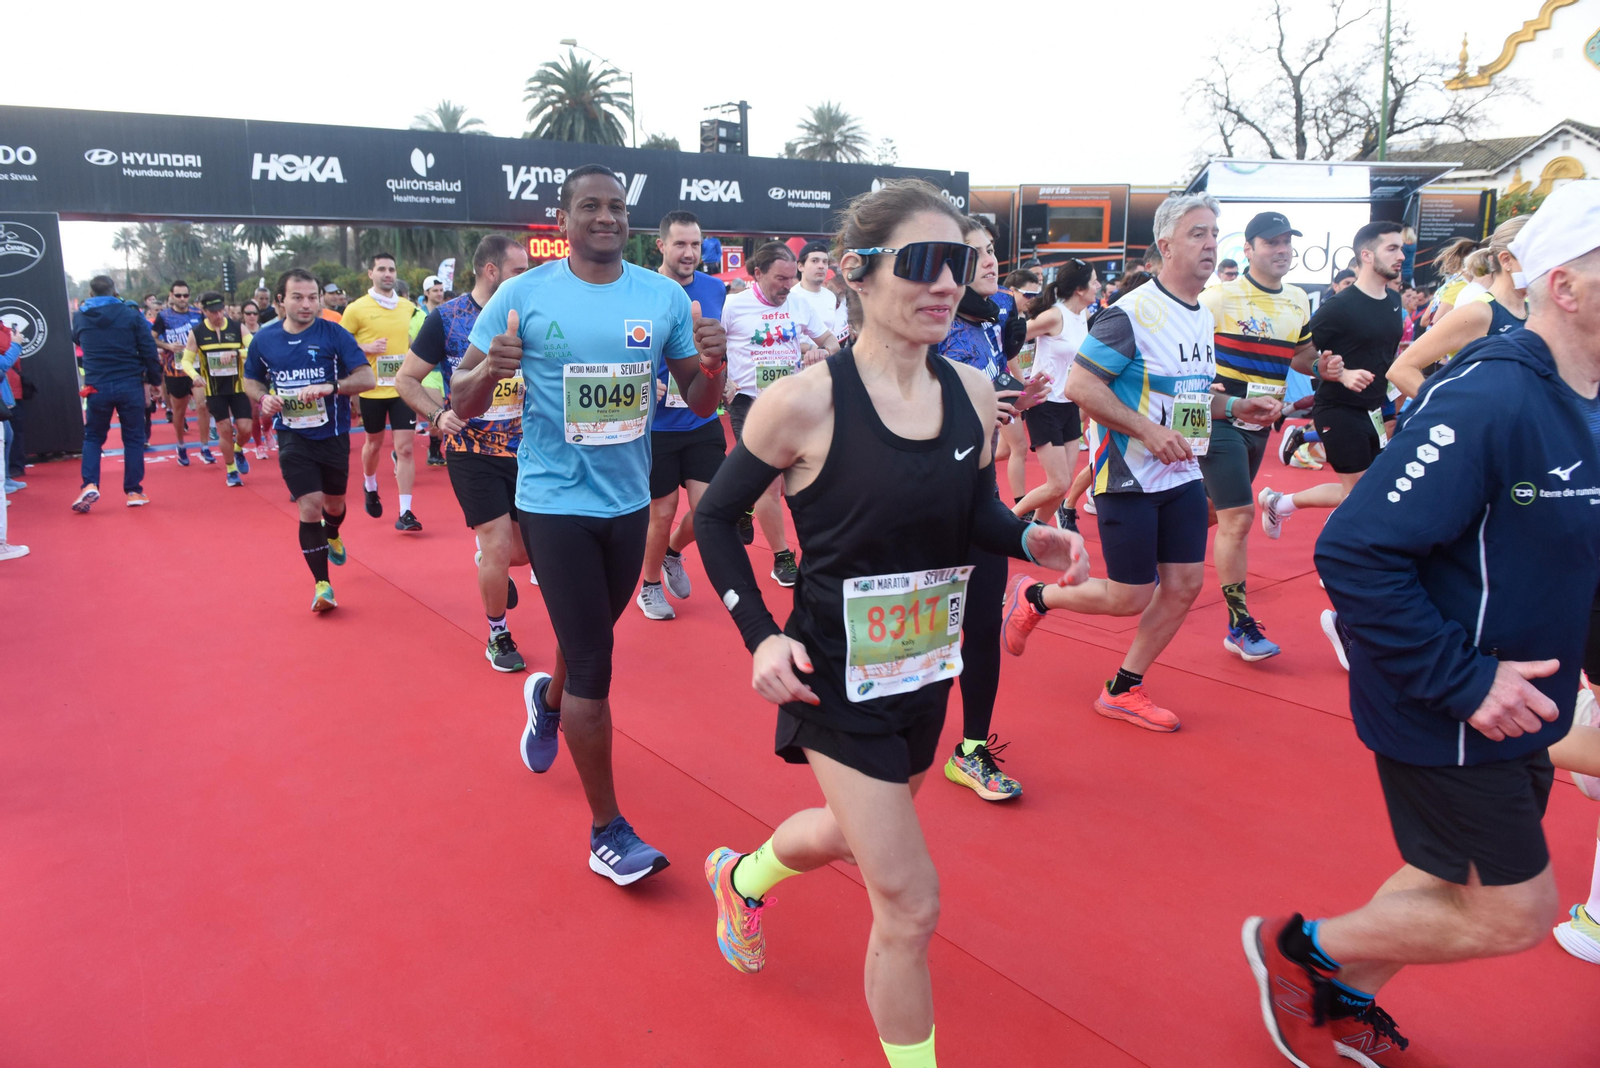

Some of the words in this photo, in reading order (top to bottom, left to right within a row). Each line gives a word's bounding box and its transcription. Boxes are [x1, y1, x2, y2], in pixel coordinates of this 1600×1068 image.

[0, 145, 37, 166] DO
[121, 152, 202, 168] HYUNDAI
[122, 167, 175, 178] Hyundauto
[175, 169, 203, 179] Motor
[252, 153, 345, 184] HOKA
[679, 178, 743, 203] HOKA
[787, 189, 831, 201] HYUNDAI
[393, 194, 431, 204] Healthcare
[431, 195, 456, 205] Partner
[762, 311, 790, 320] aefat
[544, 350, 573, 358] SEVILLA
[276, 367, 325, 382] DOLPHINS
[569, 365, 585, 374] MEDIO
[585, 364, 609, 374] MARATÓN
[620, 363, 645, 375] SEVILLA
[762, 368, 788, 382] 8979
[579, 383, 635, 409] 8049
[1182, 408, 1206, 427] 7630
[1562, 488, 1576, 497] de
[877, 575, 910, 590] MARATÓN
[924, 568, 958, 586] SEVILLA
[867, 595, 941, 643] 8317
